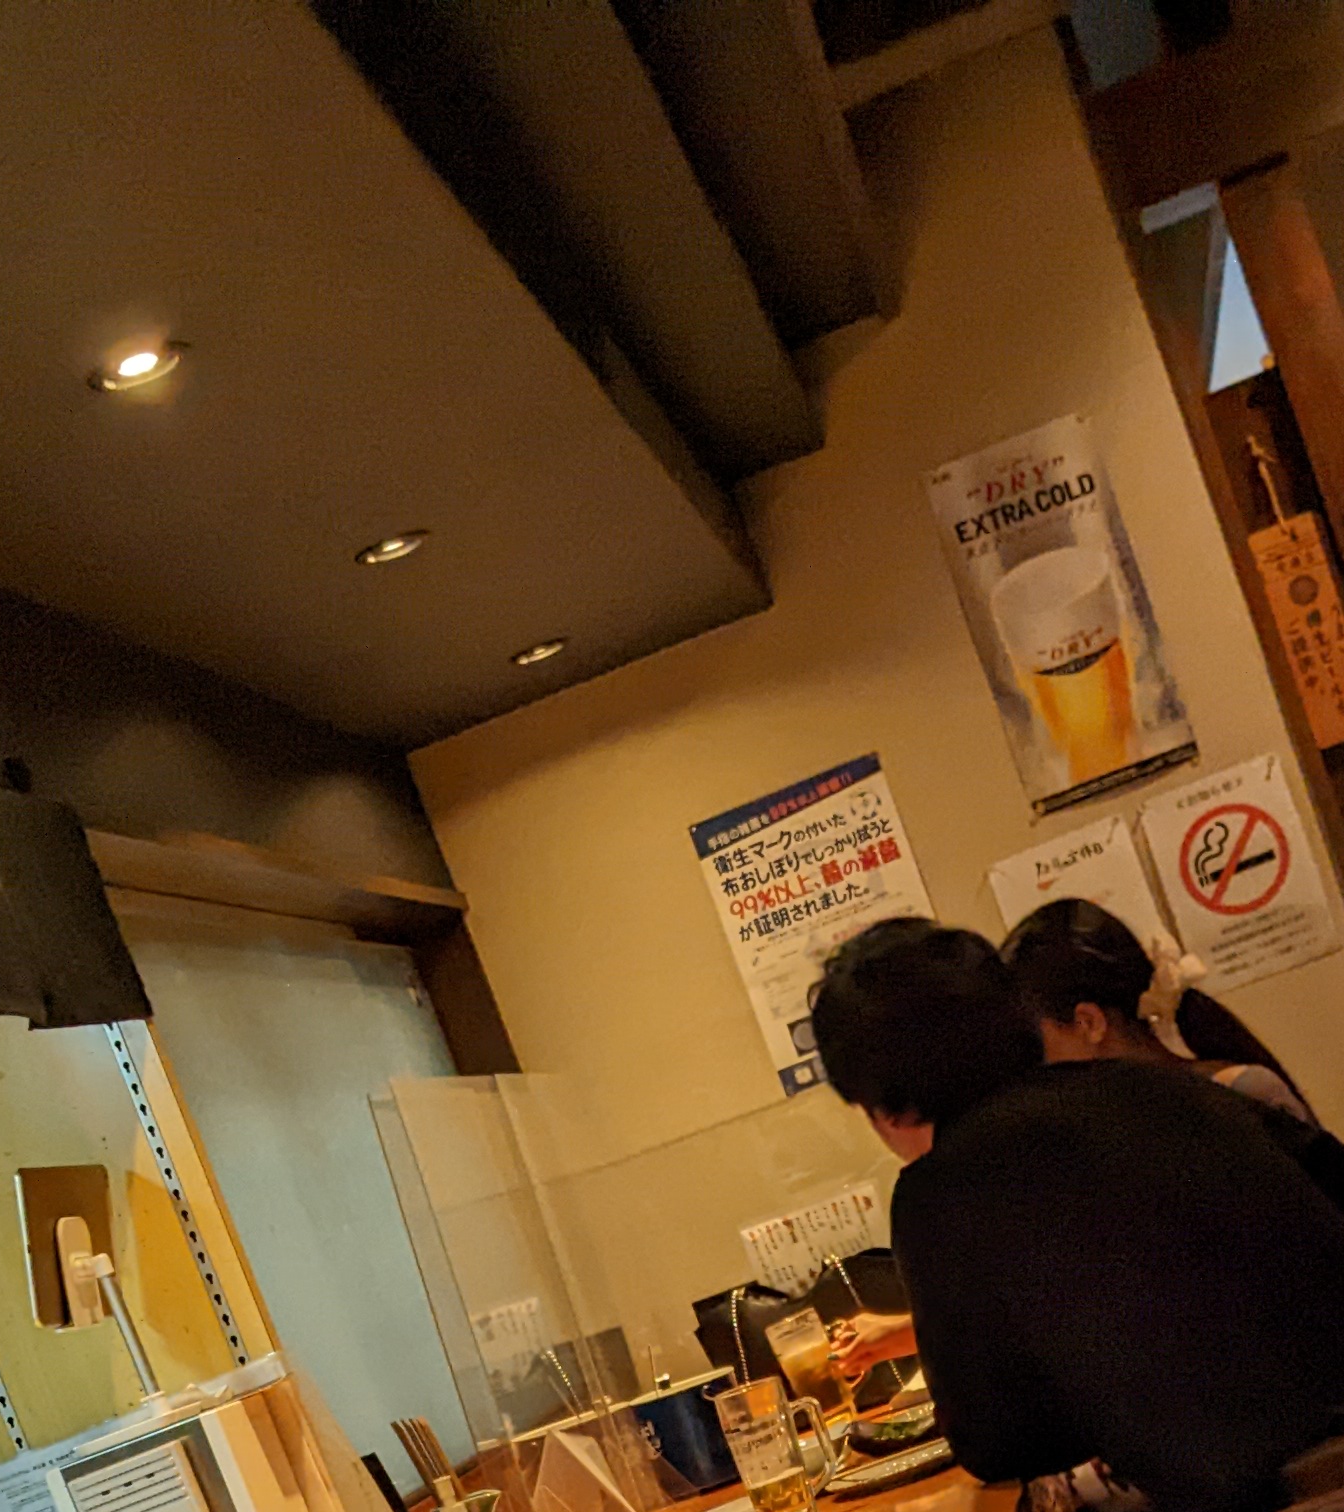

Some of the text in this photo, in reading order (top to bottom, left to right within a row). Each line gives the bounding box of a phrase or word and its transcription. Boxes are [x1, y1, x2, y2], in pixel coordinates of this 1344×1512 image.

[955, 498, 1035, 543] EXTRA
[1034, 473, 1095, 512] COLD
[713, 813, 847, 876] 衛生マークの付いた
[720, 818, 894, 898] 布おしぼりでしっかり拭うと
[738, 882, 871, 943] が証明されました。
